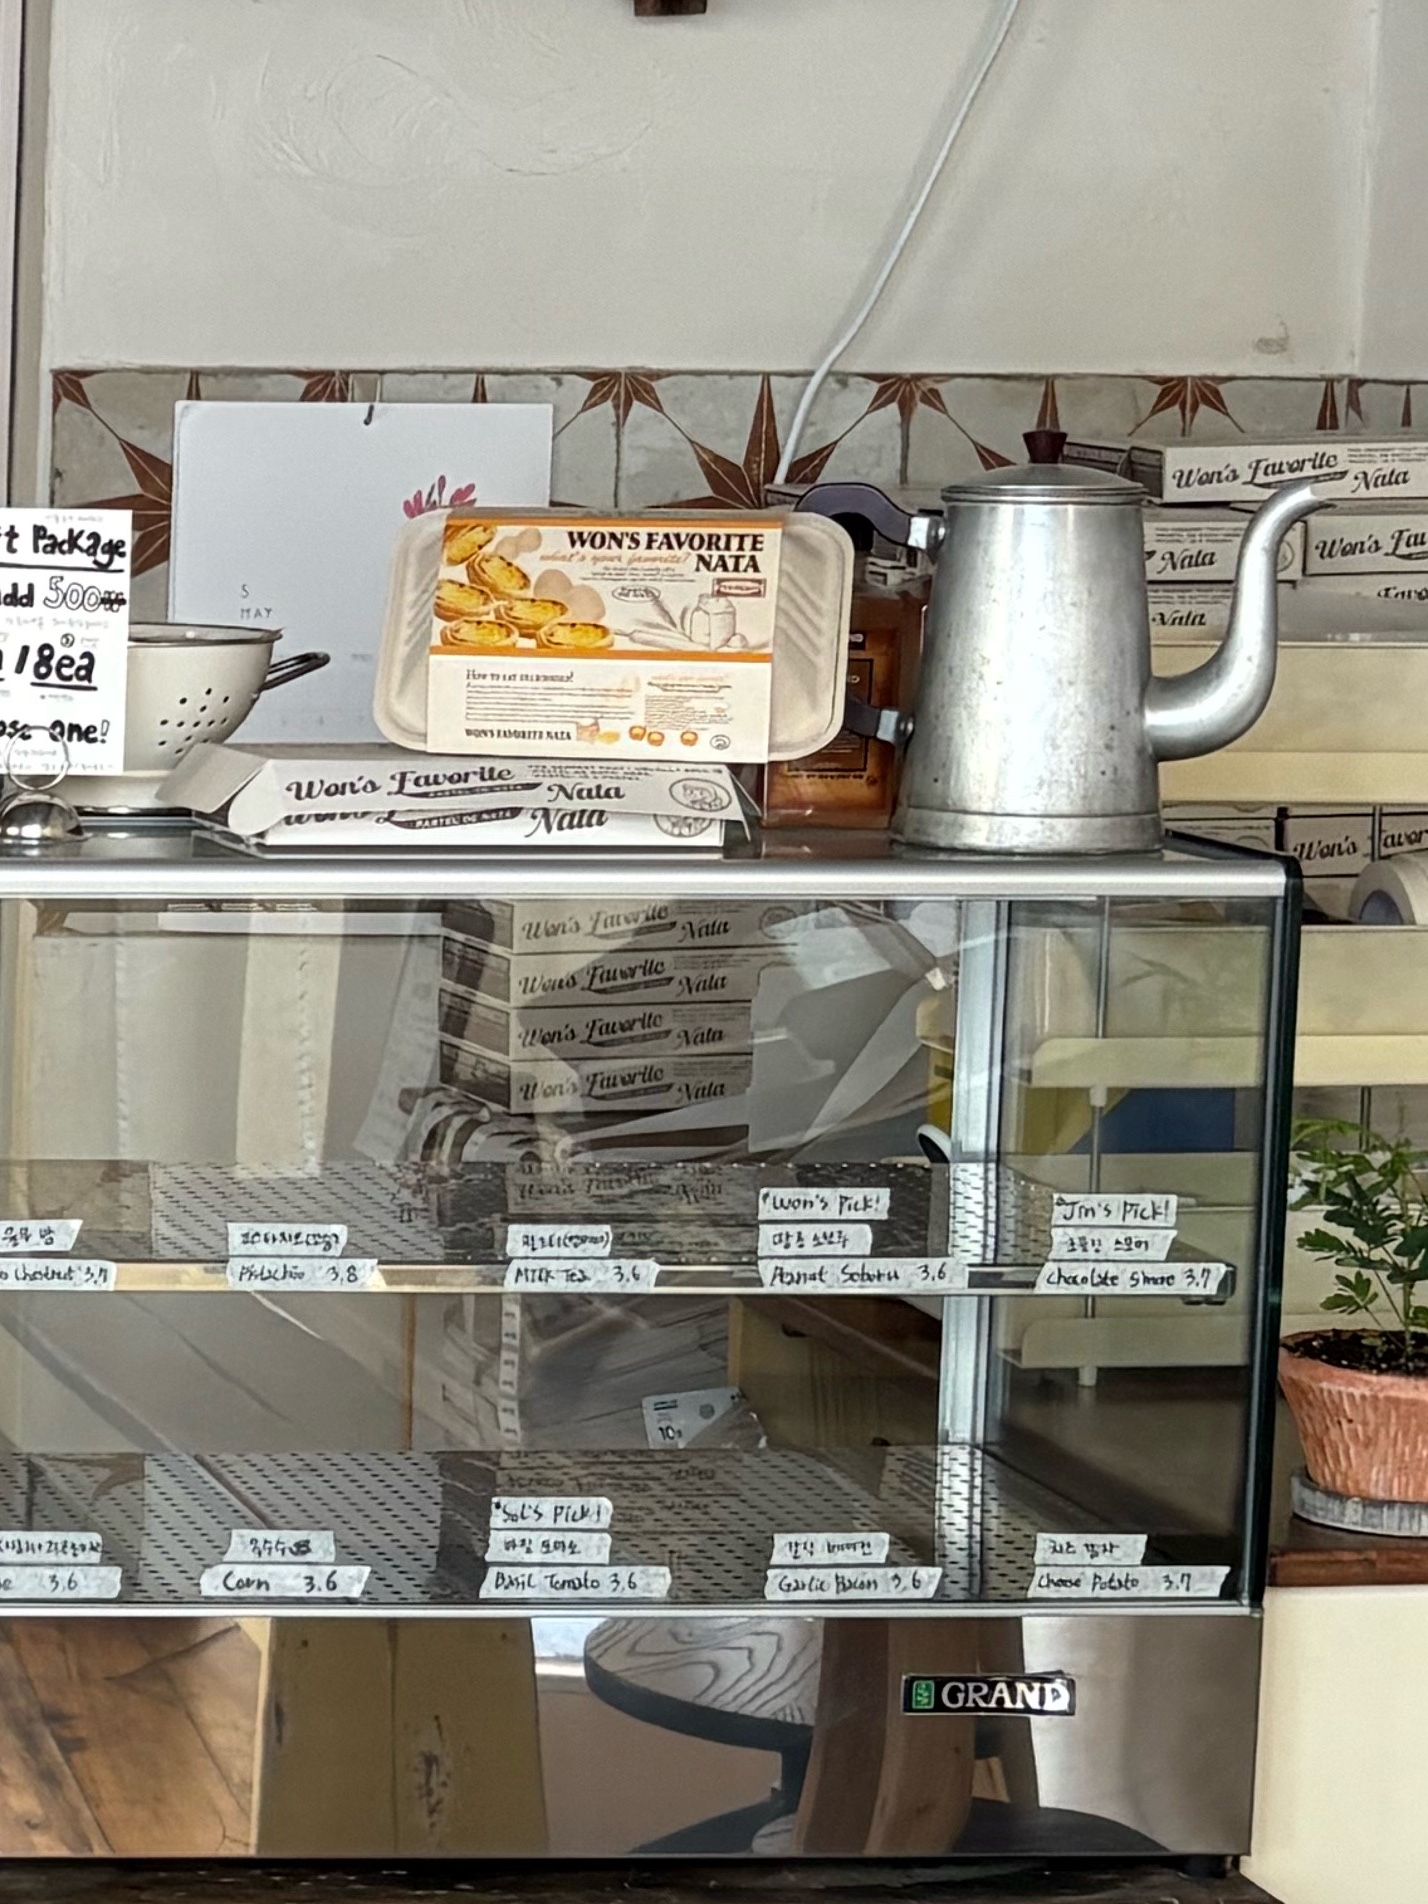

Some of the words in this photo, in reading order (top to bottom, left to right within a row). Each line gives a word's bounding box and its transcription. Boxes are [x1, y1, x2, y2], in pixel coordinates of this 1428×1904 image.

[1172, 464, 1240, 489] Won's
[1242, 451, 1339, 485] Favorite
[1350, 469, 1411, 494] Nata
[567, 530, 641, 552] WON'S
[645, 531, 765, 553] FAVORITE
[1314, 534, 1383, 560] Won's
[694, 552, 762, 574] NATA
[1156, 549, 1217, 574] Nata
[240, 607, 273, 620] MAY
[285, 773, 381, 801] Won's
[386, 766, 515, 797] Favorite
[547, 782, 626, 802] Nata
[524, 807, 610, 839] Nata
[1294, 836, 1358, 862] Won's
[522, 916, 581, 941] Won's
[584, 904, 670, 937] Favorite
[678, 918, 731, 943] Nata
[518, 1023, 577, 1048] Won's
[579, 1012, 664, 1046] Favorite
[222, 1570, 271, 1592] Corn
[303, 1569, 339, 1593] 3.6
[941, 1680, 1071, 1713] GRAND
